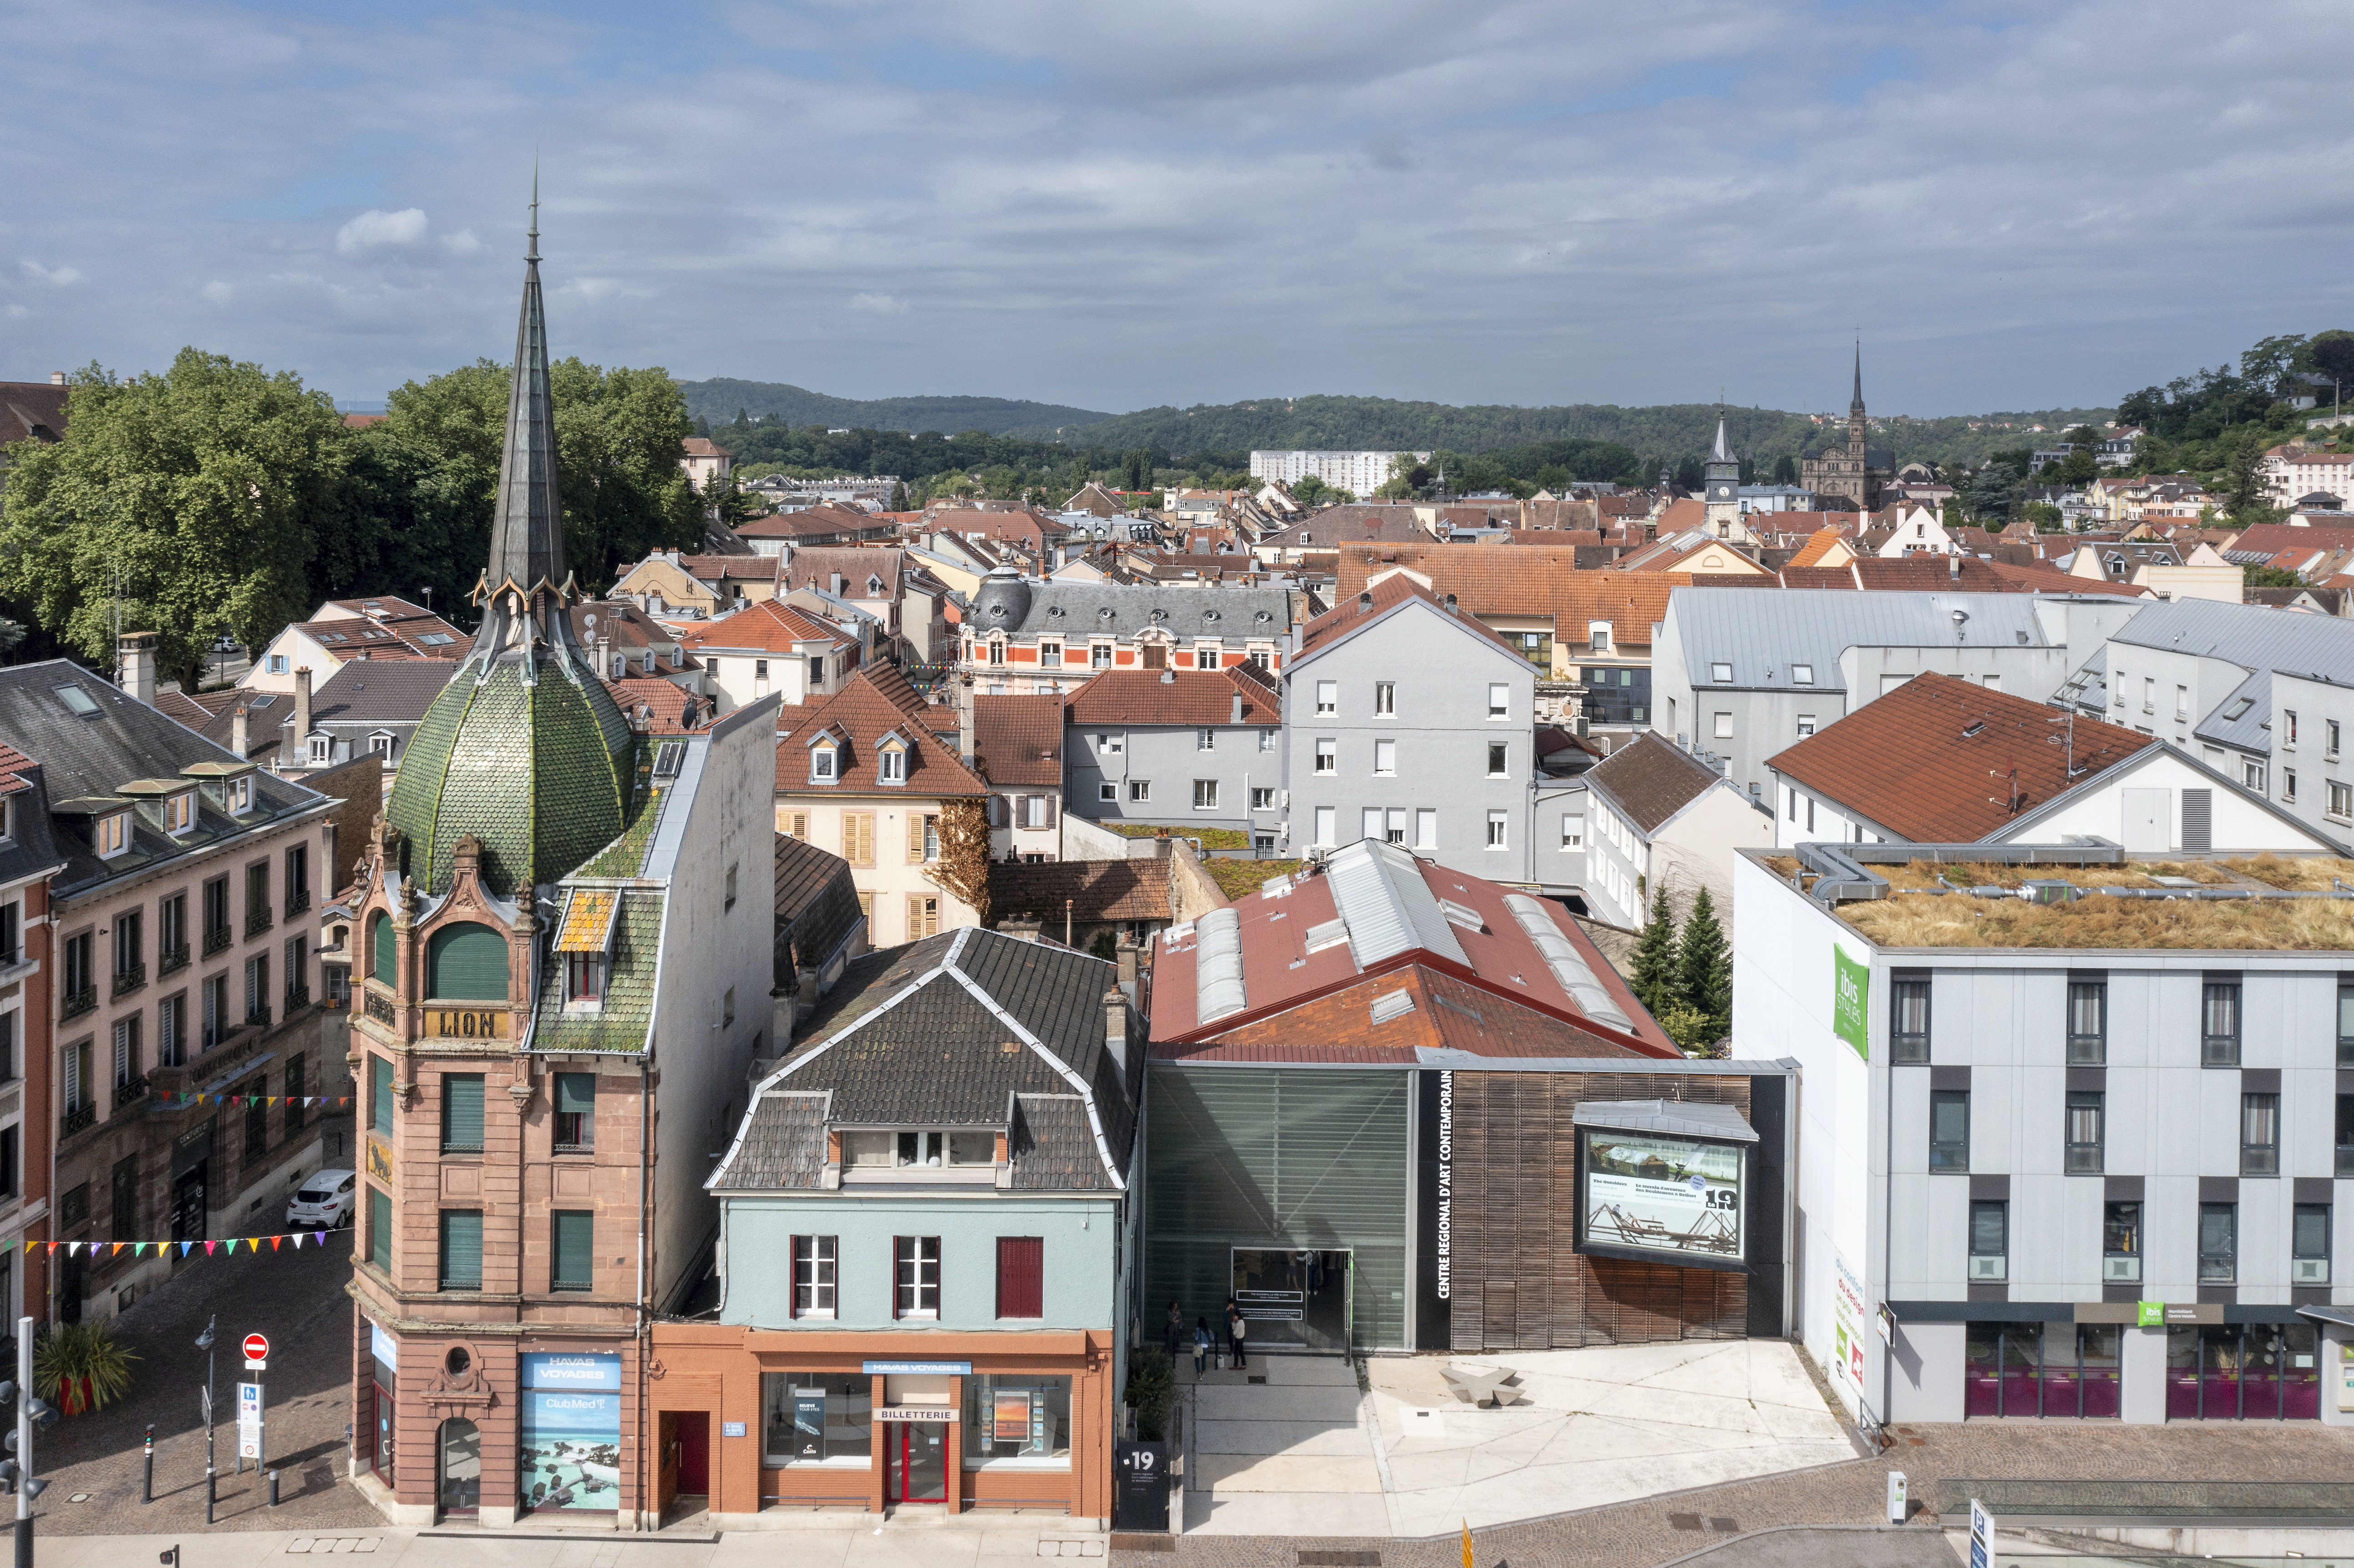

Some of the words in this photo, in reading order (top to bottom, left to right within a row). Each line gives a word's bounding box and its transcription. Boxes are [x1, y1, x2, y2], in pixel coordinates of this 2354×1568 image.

[1841, 967, 1858, 1004] ibis
[440, 1010, 495, 1038] LION
[1440, 1071, 1451, 1161] CONTEMPORAIN
[1706, 1189, 1737, 1210] 19
[1439, 1199, 1450, 1255] REGIONAL
[1438, 1257, 1450, 1299] CENTRE
[1837, 1258, 1843, 1272] du
[1844, 1268, 1863, 1297] confort
[1837, 1293, 1842, 1304] un
[1843, 1301, 1851, 1316] prix
[1839, 1278, 1845, 1293] du
[1847, 1288, 1864, 1317] design
[2146, 1307, 2161, 1316] ibis
[1837, 1305, 1845, 1323] tout
[1846, 1319, 1863, 1347] compris
[540, 1370, 604, 1379] VOYAGES
[550, 1357, 595, 1366] HAVAS
[547, 1399, 571, 1408] Club
[572, 1399, 595, 1409] Med
[1131, 1451, 1154, 1470] 19
